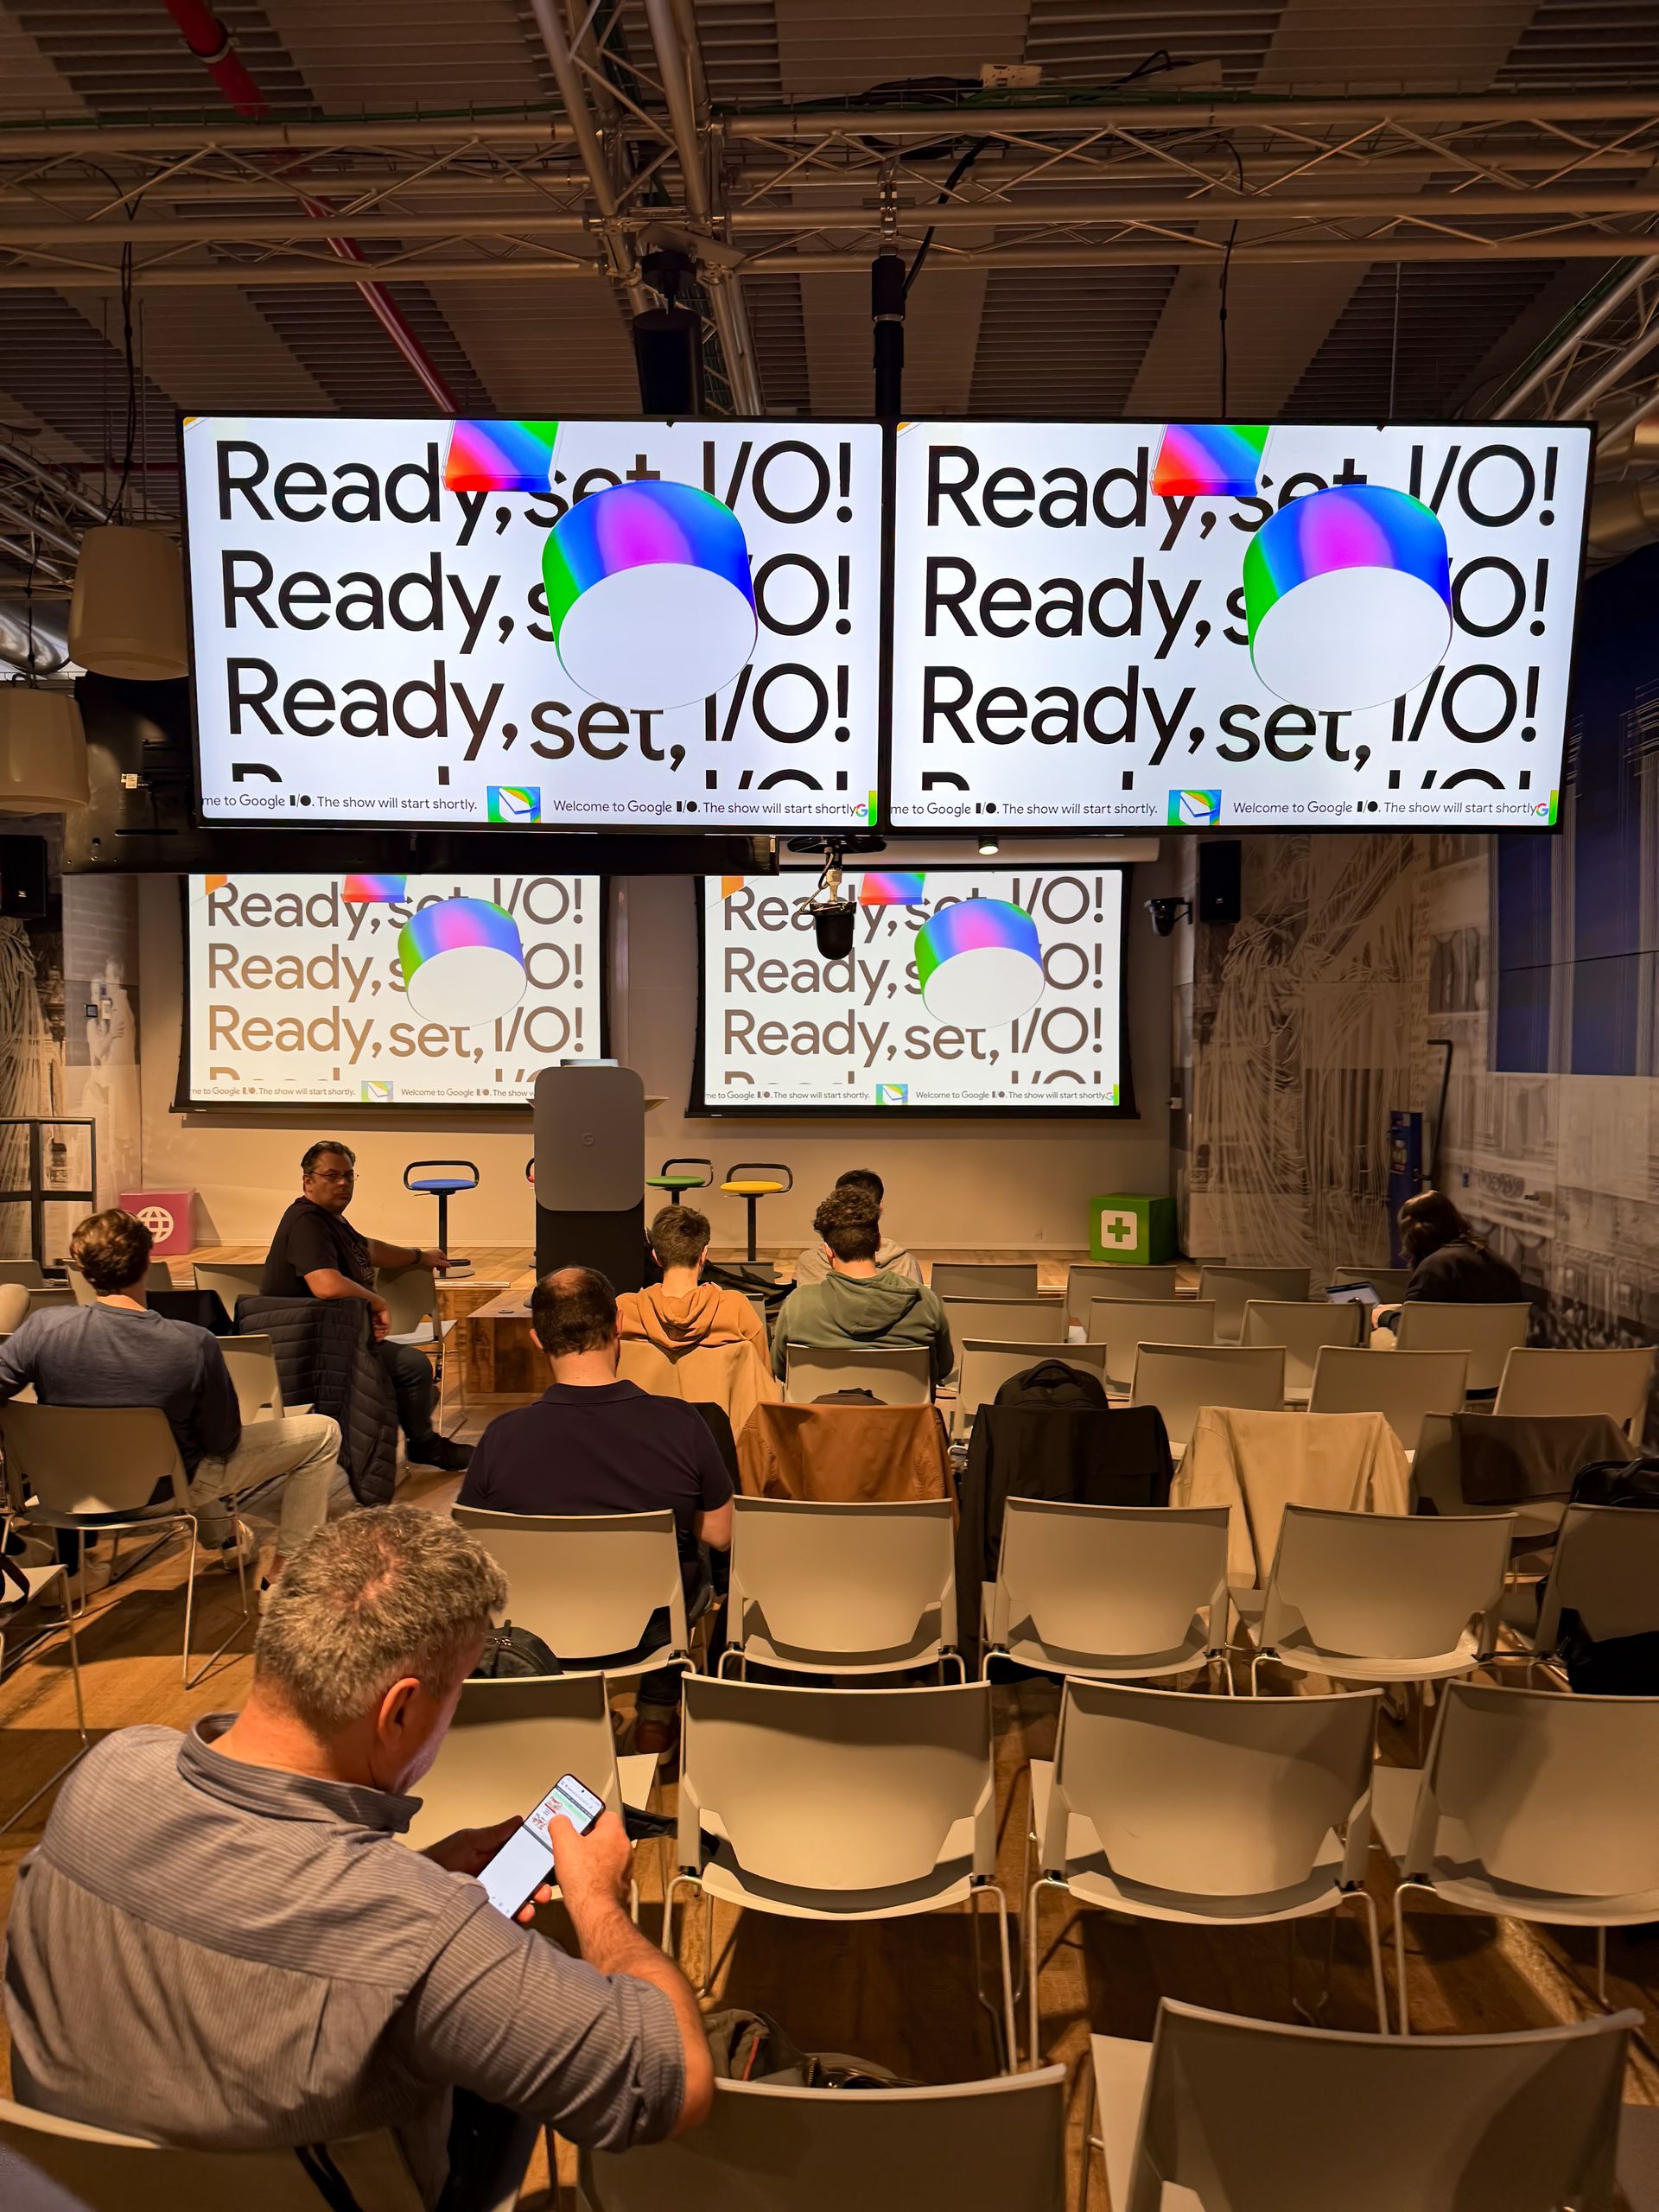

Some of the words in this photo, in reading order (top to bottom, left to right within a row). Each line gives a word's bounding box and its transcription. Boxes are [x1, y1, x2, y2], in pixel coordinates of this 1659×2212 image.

[217, 441, 511, 546] Ready,
[703, 441, 852, 524] I/O!
[928, 445, 1216, 550] Ready,
[1409, 445, 1558, 527] I/O!
[222, 550, 514, 654] Ready,
[749, 554, 851, 636] O!
[925, 556, 1211, 659] Ready,
[1446, 556, 1548, 637] O!
[227, 658, 518, 760] Ready,
[531, 702, 685, 772] set,
[705, 664, 849, 743] I/O!
[923, 665, 1205, 766] Ready,
[1217, 704, 1370, 772] set,
[1392, 664, 1540, 743] I/O!
[224, 796, 237, 806] to
[239, 793, 284, 809] Google
[317, 797, 340, 808] The
[343, 796, 375, 808] show
[378, 797, 397, 809] will
[401, 798, 429, 809] start
[433, 798, 477, 810] shortly.
[554, 800, 609, 812] Welcome
[613, 802, 625, 812] to
[627, 800, 671, 816] Google
[702, 802, 725, 813] The
[728, 803, 760, 814] show
[762, 803, 781, 814] will
[785, 804, 812, 814] start
[855, 804, 868, 817] G
[912, 804, 925, 815] to
[927, 802, 971, 817] Google
[1002, 804, 1024, 815] The
[1027, 804, 1058, 815] show
[1062, 804, 1081, 815] will
[1084, 804, 1111, 815] start
[1115, 803, 1158, 817] shortly.
[1233, 802, 1289, 813] Welcome
[1293, 803, 1305, 813] to
[1307, 800, 1352, 816] Google
[1384, 802, 1406, 813] The
[1408, 802, 1441, 813] show
[1444, 802, 1462, 813] will
[1465, 803, 1493, 813] start
[1535, 803, 1548, 817] G
[725, 885, 897, 944] Reay,
[208, 944, 381, 1002] Ready,
[725, 947, 897, 1006] Ready,
[208, 1006, 381, 1065] Ready,
[389, 1023, 483, 1064] set,
[495, 1006, 584, 1052] I/O!
[725, 1009, 897, 1067] Ready,
[905, 1026, 999, 1065] set,
[1012, 1007, 1103, 1054] I/O!
[213, 1087, 240, 1096] Google
[296, 1087, 308, 1096] will
[328, 1088, 356, 1096] shortly.
[446, 1088, 474, 1097] Google
[727, 1090, 755, 1101] Google
[842, 1091, 870, 1101] shortly.
[961, 1090, 989, 1101] Google
